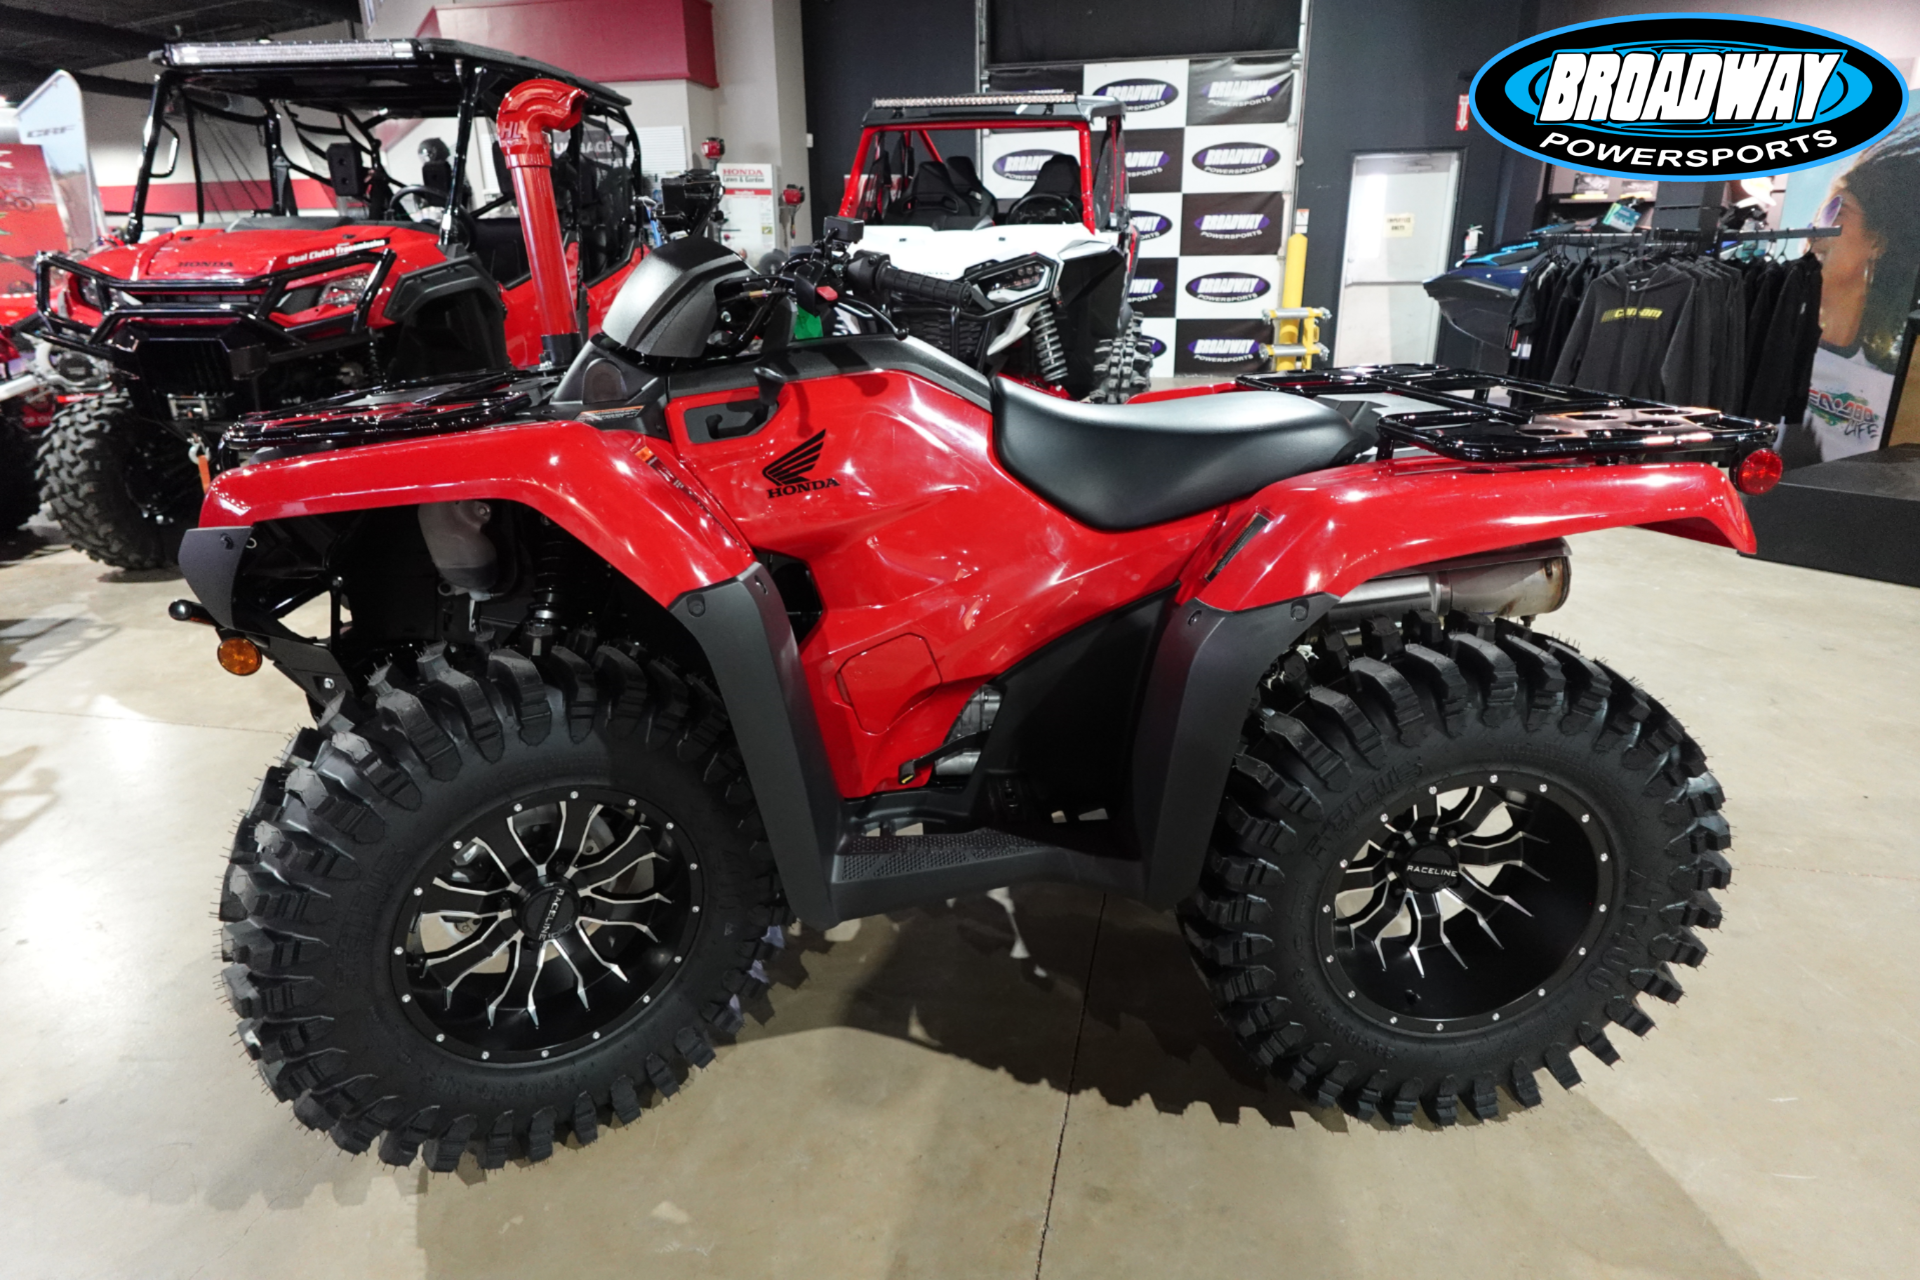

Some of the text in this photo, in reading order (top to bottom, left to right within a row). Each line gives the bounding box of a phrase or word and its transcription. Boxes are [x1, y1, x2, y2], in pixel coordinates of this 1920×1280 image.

[1208, 80, 1275, 98] BROADWAY
[1208, 95, 1272, 107] POWERSPORTS
[1204, 148, 1269, 165] BROADWAY
[1204, 163, 1267, 175] POWERSPORTS
[1201, 214, 1264, 231] BROADWAY
[1201, 229, 1263, 240] POWERSPORTS
[287, 239, 386, 265] Dual Clutch Transmission
[178, 261, 234, 269] HONDA
[1196, 278, 1260, 294] BROADWAY
[1196, 292, 1258, 303] POWERSPORTS
[1194, 339, 1256, 355] BROADWAY
[1194, 353, 1254, 363] POWERSPORTS
[1844, 421, 1880, 440] LIFE
[767, 477, 841, 499] HONDA
[1406, 864, 1458, 877] RACELINE
[538, 888, 565, 940] RACELINE
